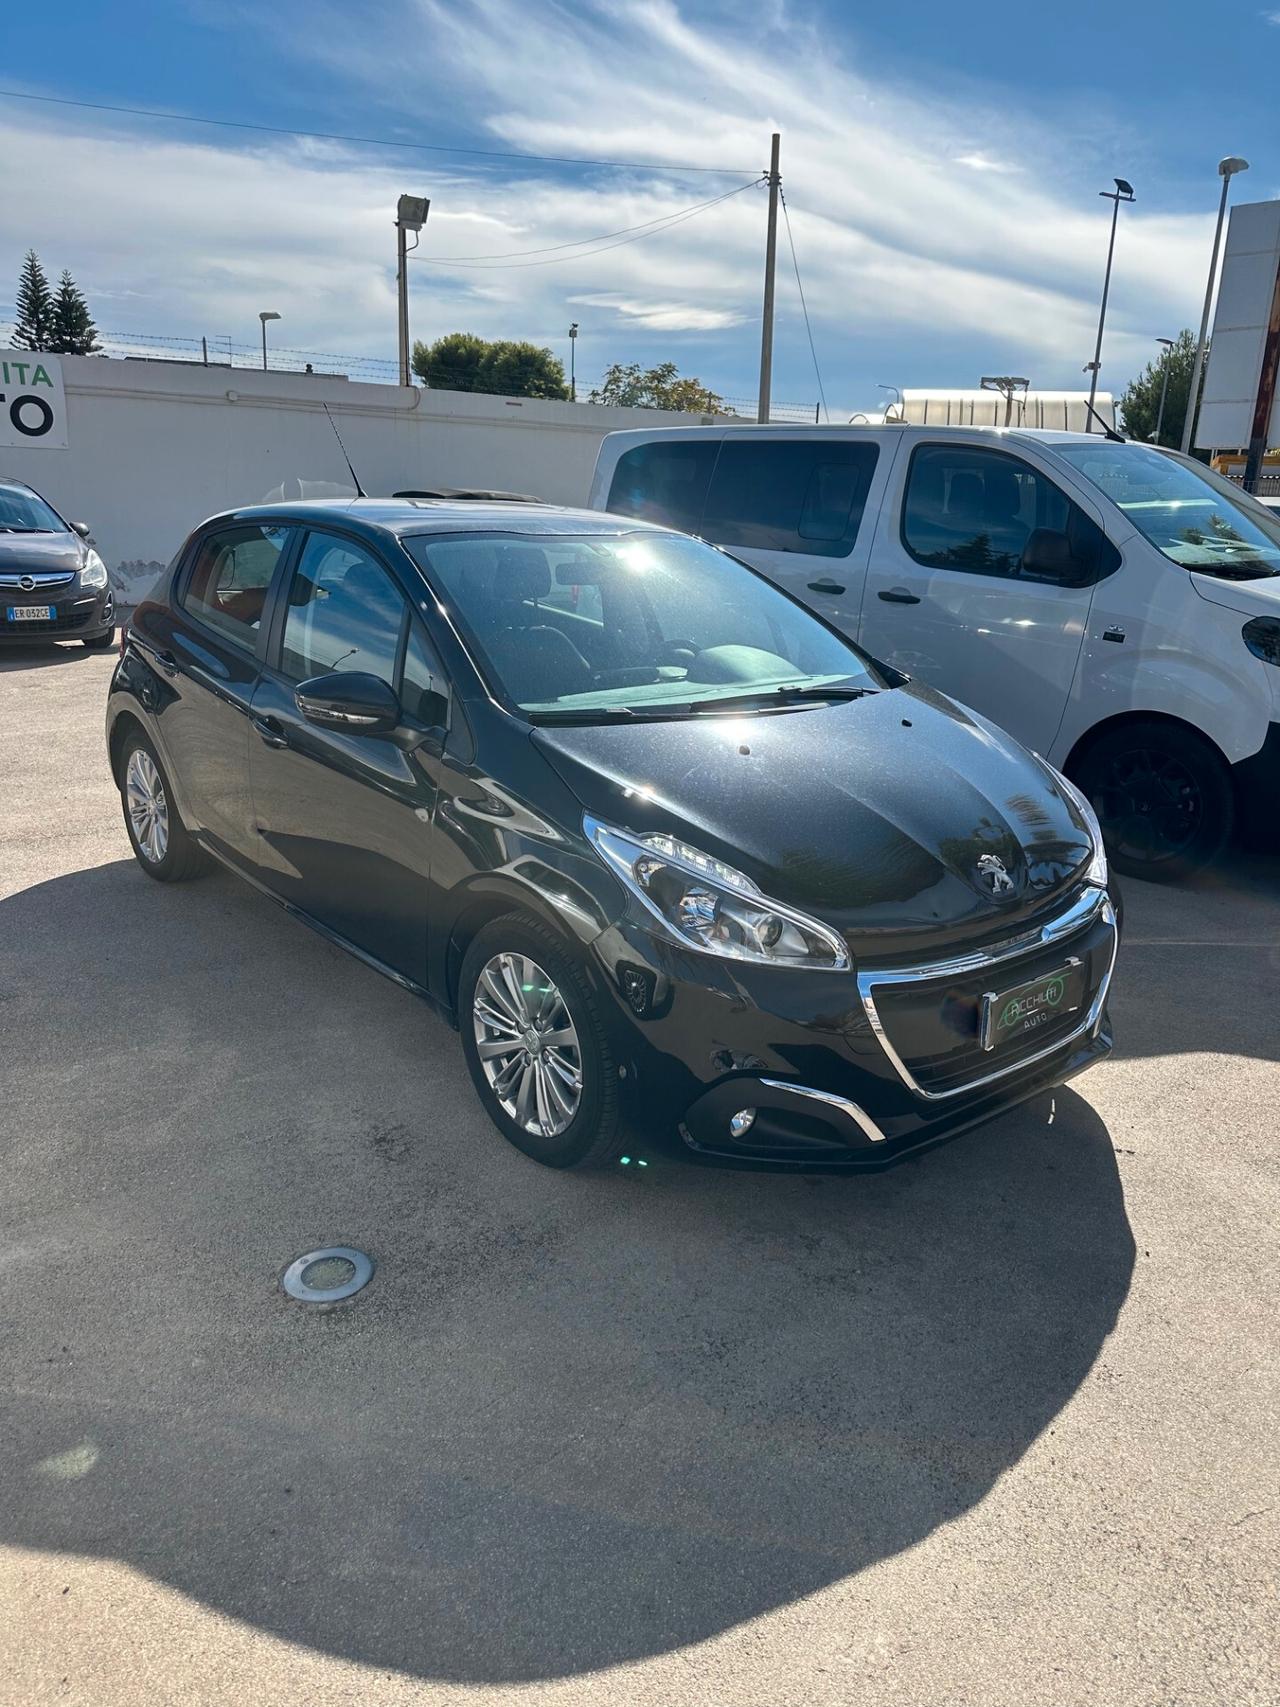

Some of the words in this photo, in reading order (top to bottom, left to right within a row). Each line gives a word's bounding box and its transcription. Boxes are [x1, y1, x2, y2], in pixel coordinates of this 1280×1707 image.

[2, 362, 54, 388] ITA
[0, 393, 54, 436] O
[1024, 1012, 1047, 1029] AUTO
